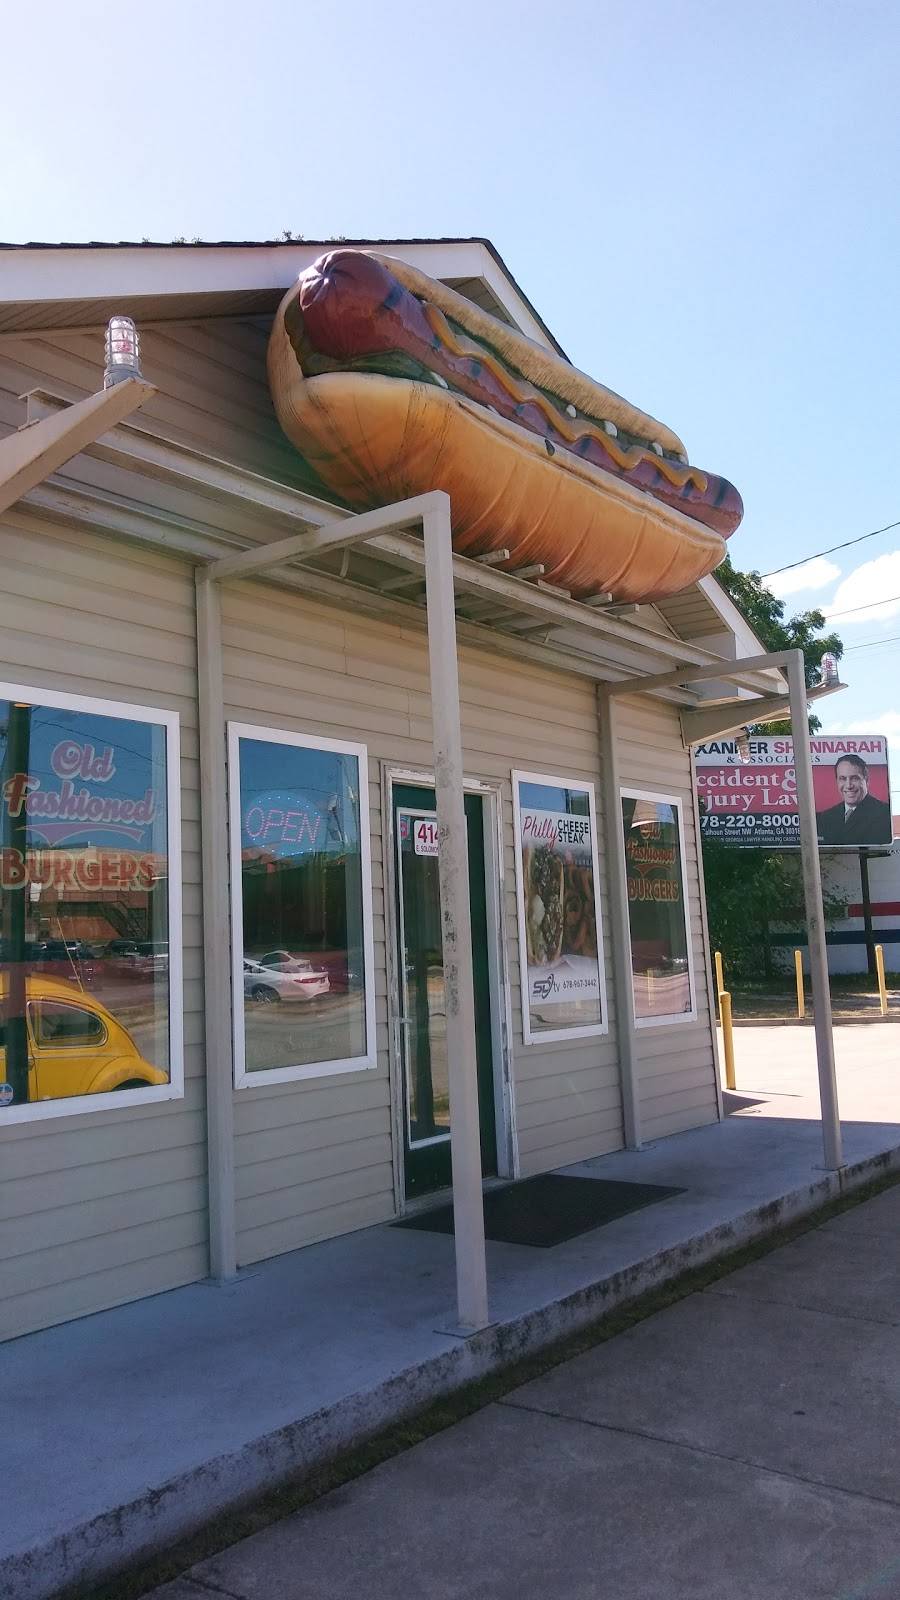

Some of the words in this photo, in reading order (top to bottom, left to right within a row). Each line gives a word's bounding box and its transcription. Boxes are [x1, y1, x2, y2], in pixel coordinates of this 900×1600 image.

[695, 741, 768, 754] XANER
[774, 741, 881, 754] SHNNARAH
[727, 755, 736, 764] &
[51, 740, 116, 782] Old
[696, 768, 779, 787] ccident
[3, 773, 158, 825] Fashioned
[705, 789, 756, 812] jury
[245, 806, 321, 844] OPEN
[523, 815, 557, 848] Philly
[557, 819, 589, 834] CHEESE
[701, 814, 800, 828] 78-220-8000
[558, 831, 585, 844] STEAK
[627, 837, 677, 865] Fashioned
[0, 847, 158, 892] BURGERS
[627, 877, 680, 902] BURGERS
